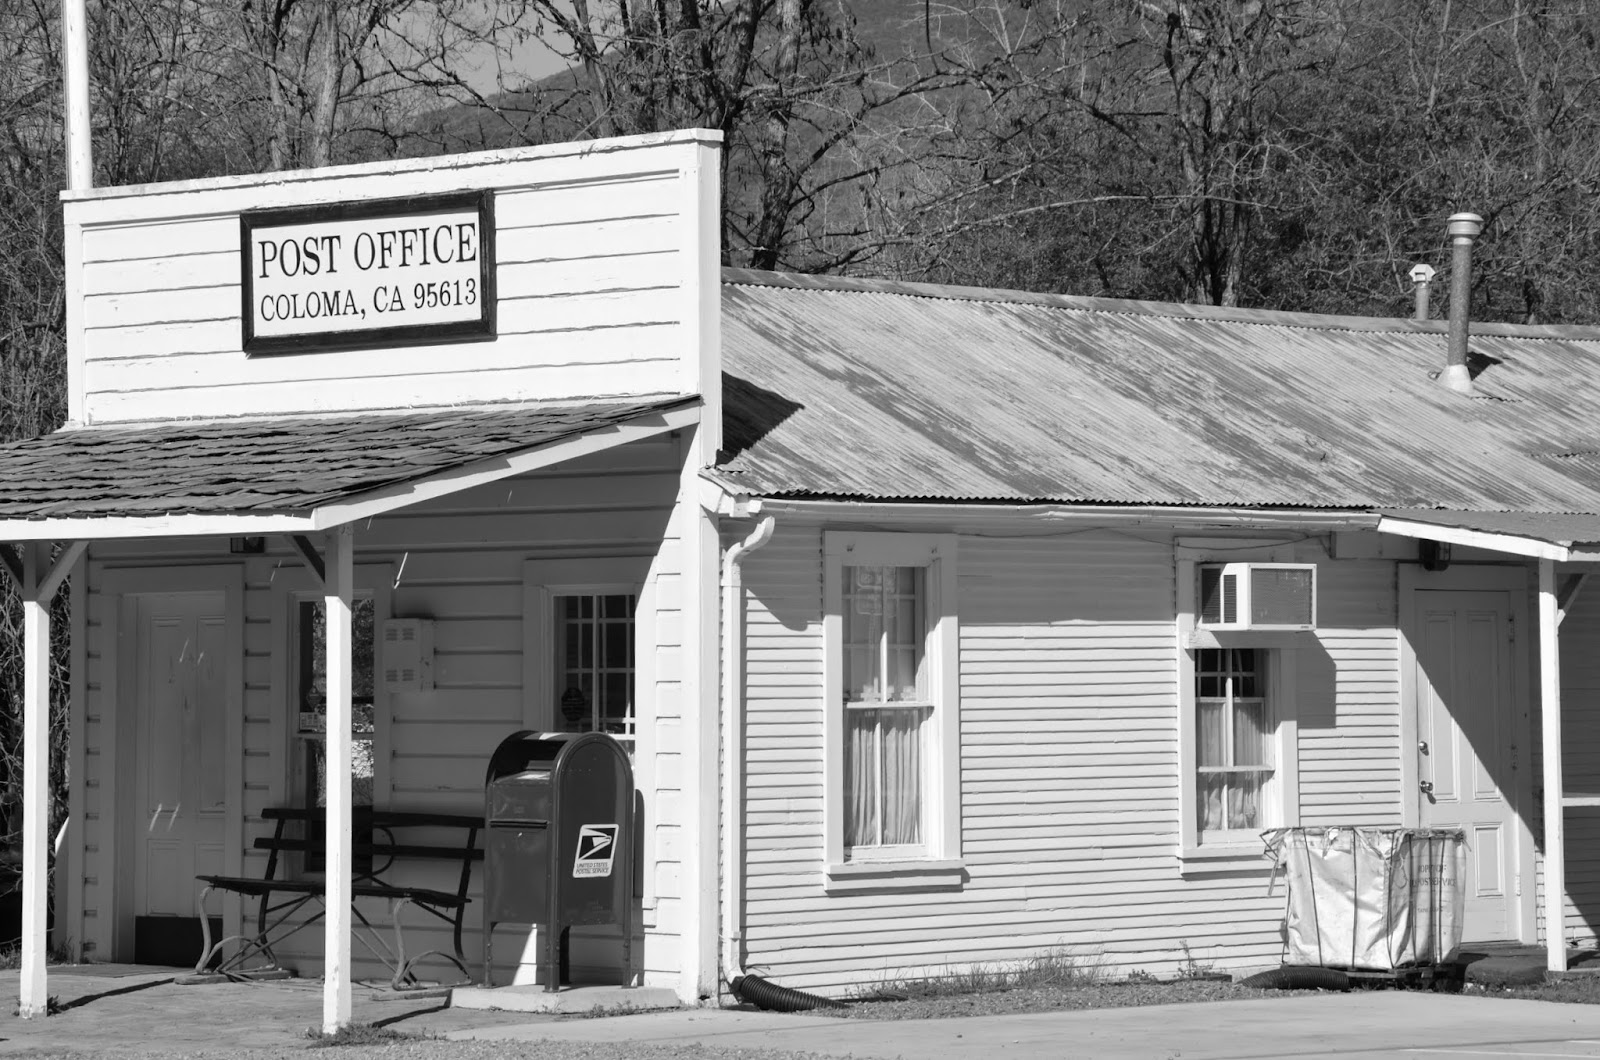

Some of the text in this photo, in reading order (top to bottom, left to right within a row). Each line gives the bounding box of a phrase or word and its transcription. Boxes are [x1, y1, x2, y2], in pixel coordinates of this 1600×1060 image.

[258, 222, 477, 278] POST OFFICE
[260, 278, 477, 322] COLOMA, CA 95613
